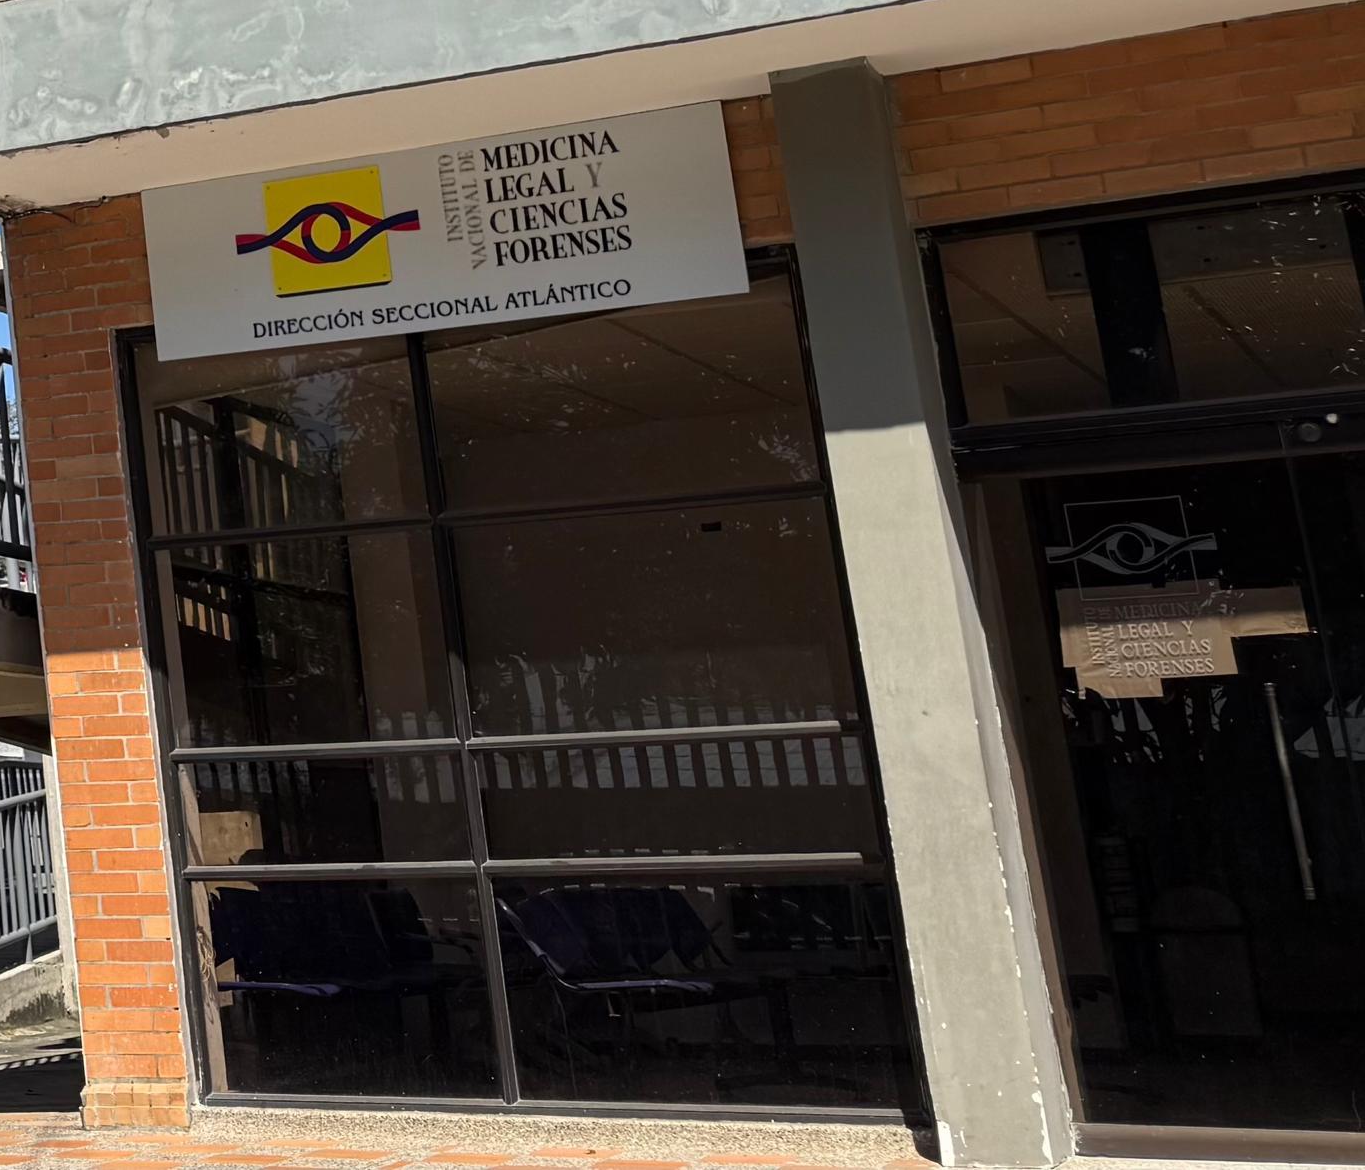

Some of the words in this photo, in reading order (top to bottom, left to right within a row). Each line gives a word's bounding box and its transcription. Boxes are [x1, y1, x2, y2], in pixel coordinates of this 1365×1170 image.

[457, 150, 476, 173] DE
[480, 130, 620, 172] MEDICINA
[438, 154, 463, 242] INSTITUTO
[484, 167, 575, 204] LEGAL
[585, 161, 603, 189] Y
[489, 192, 628, 235] CIENCIAS
[493, 225, 632, 267] FORENSES
[252, 308, 364, 339] DIRECCIÓN
[372, 295, 498, 325] SECCIONAL
[505, 279, 632, 310] ATLÁNTICO
[1116, 621, 1174, 640] LEGAL
[1181, 620, 1193, 637] Y
[1121, 639, 1211, 660] CIENCIAS
[1125, 658, 1215, 678] FORENSES
